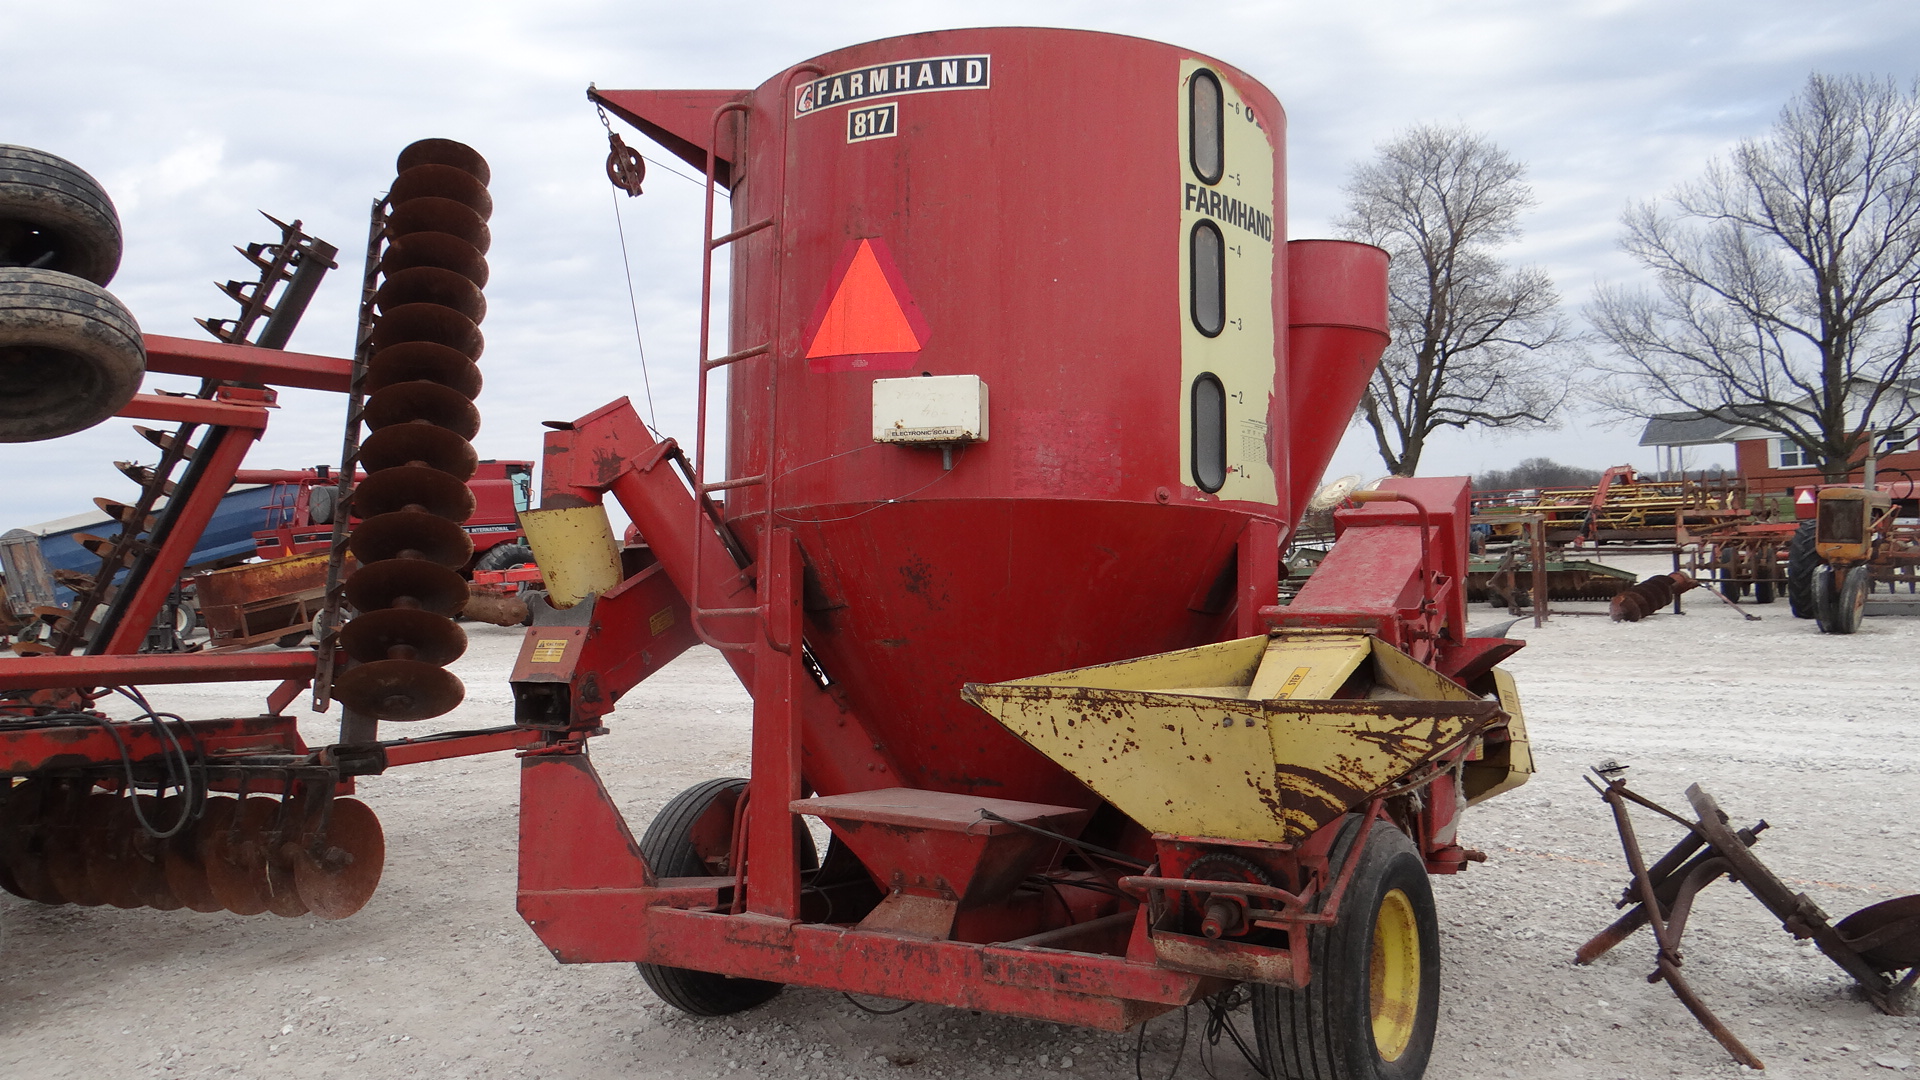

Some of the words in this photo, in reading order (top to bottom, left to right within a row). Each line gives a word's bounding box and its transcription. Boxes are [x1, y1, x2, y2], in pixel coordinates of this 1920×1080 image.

[816, 60, 982, 106] FARMHAND
[854, 109, 890, 137] 817
[1185, 182, 1272, 243] FARMHAND
[1288, 674, 1301, 685] STEP
